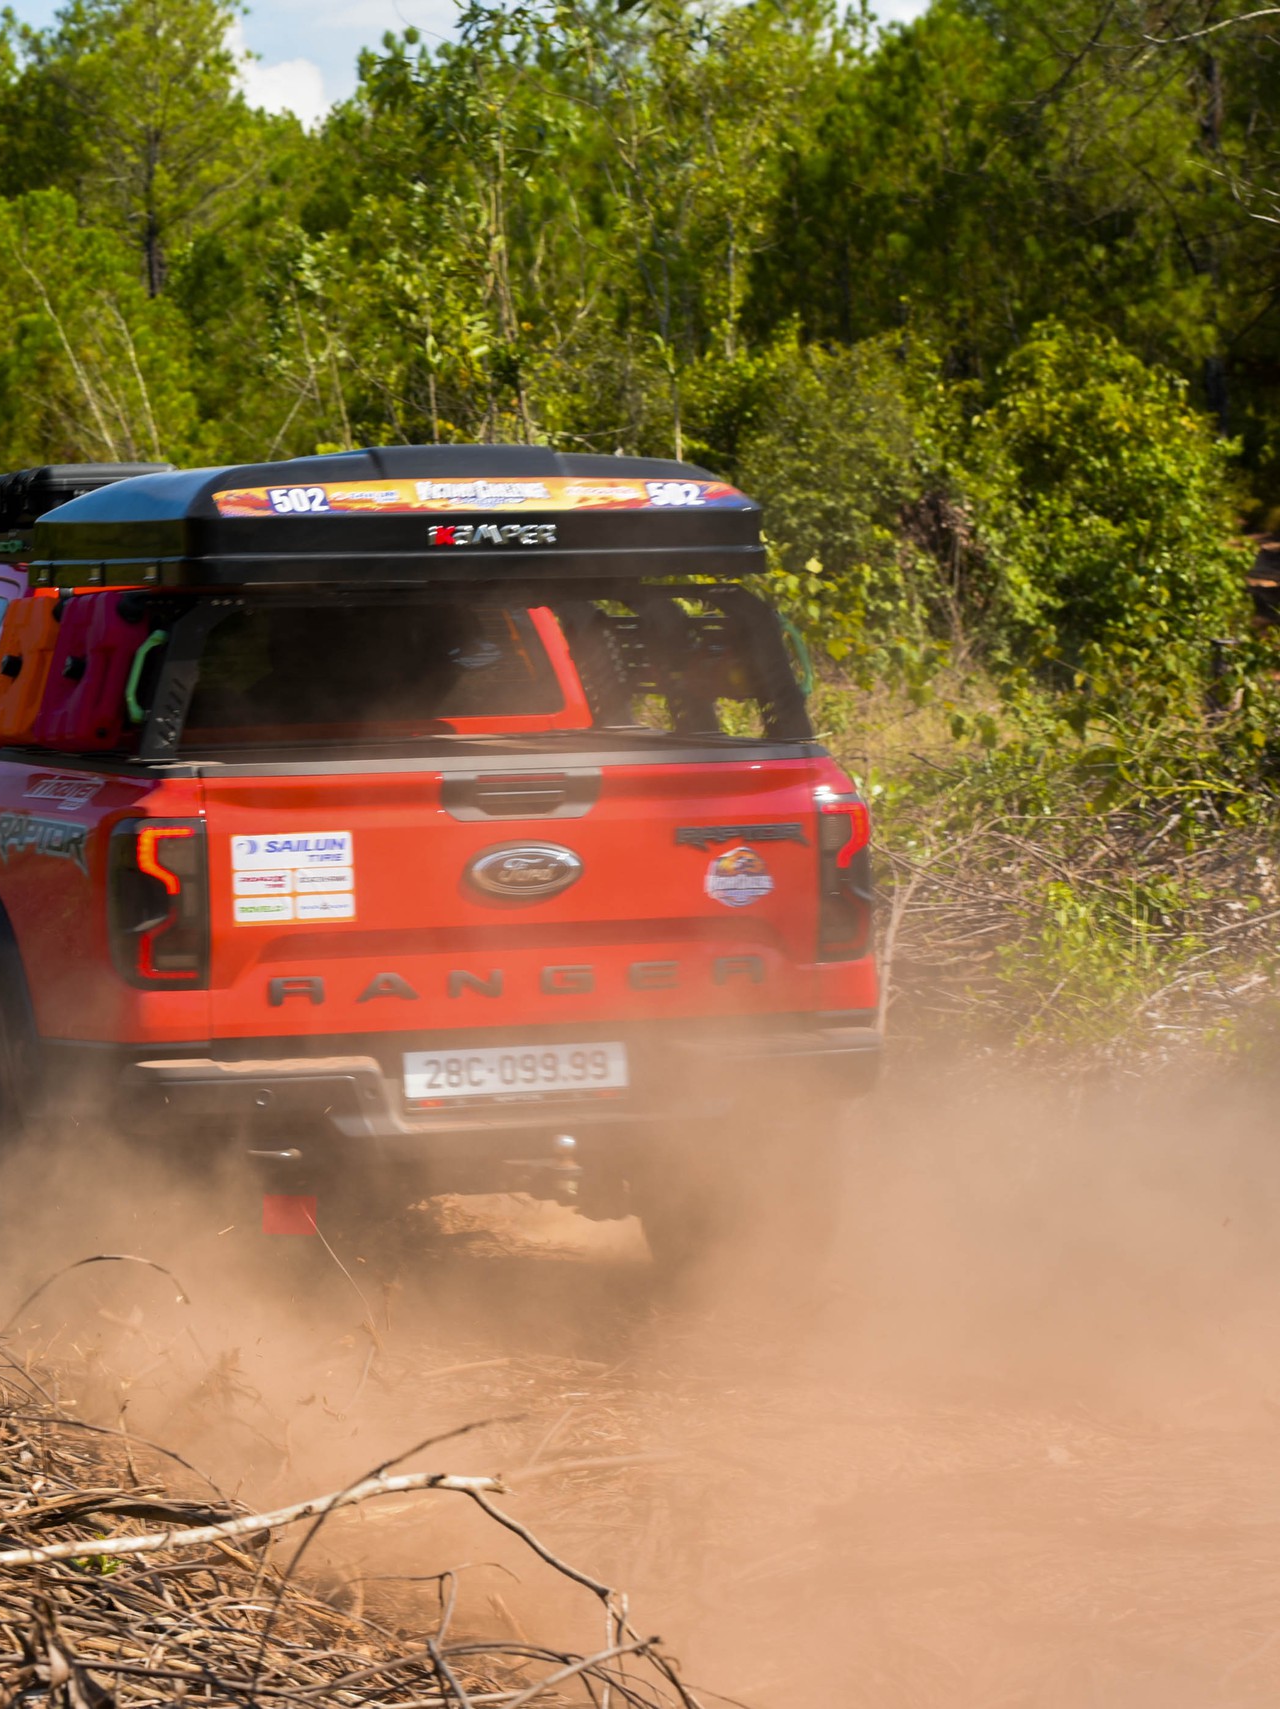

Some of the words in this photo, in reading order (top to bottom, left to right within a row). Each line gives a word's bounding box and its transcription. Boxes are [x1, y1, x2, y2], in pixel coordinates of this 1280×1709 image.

[270, 488, 330, 513] 502
[646, 483, 706, 505] 502
[265, 838, 346, 853] SAILUN
[308, 853, 343, 862] TIRE
[267, 954, 767, 1007] RANGER
